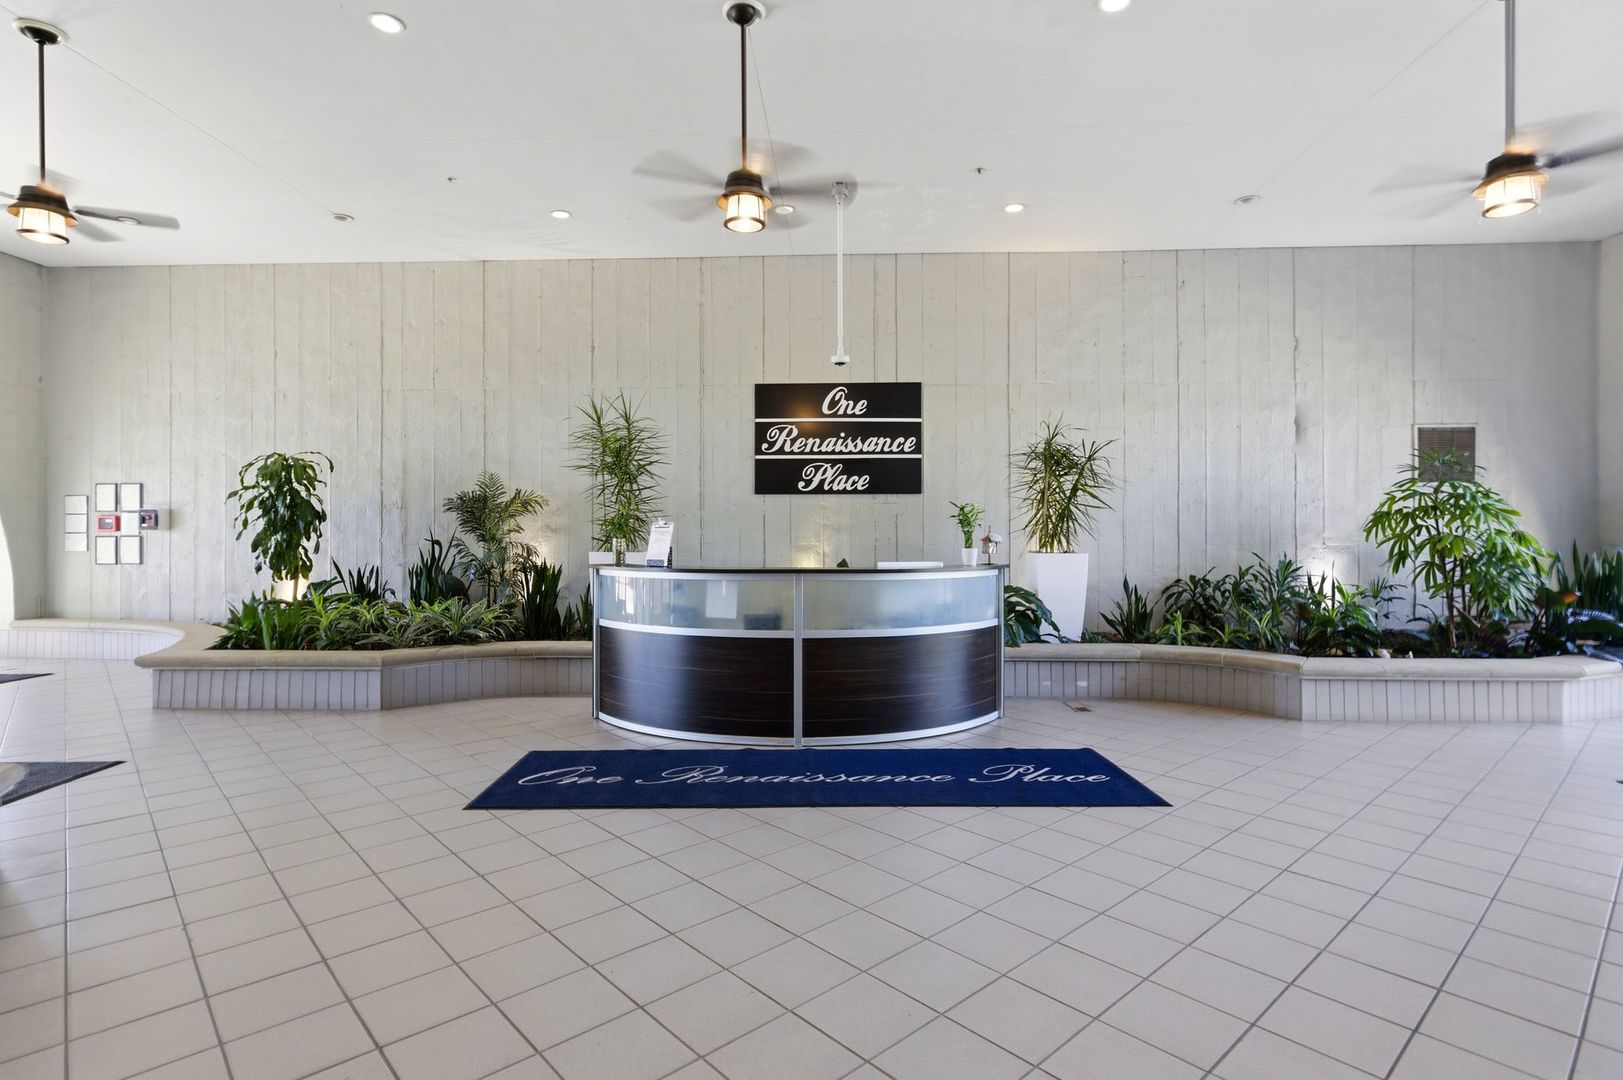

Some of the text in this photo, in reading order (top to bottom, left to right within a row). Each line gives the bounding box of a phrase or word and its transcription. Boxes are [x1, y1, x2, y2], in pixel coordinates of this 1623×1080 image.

[821, 386, 868, 415] One
[761, 424, 917, 453] Renaissance
[797, 462, 870, 491] Place
[518, 763, 1111, 785] One Renaissance Place
